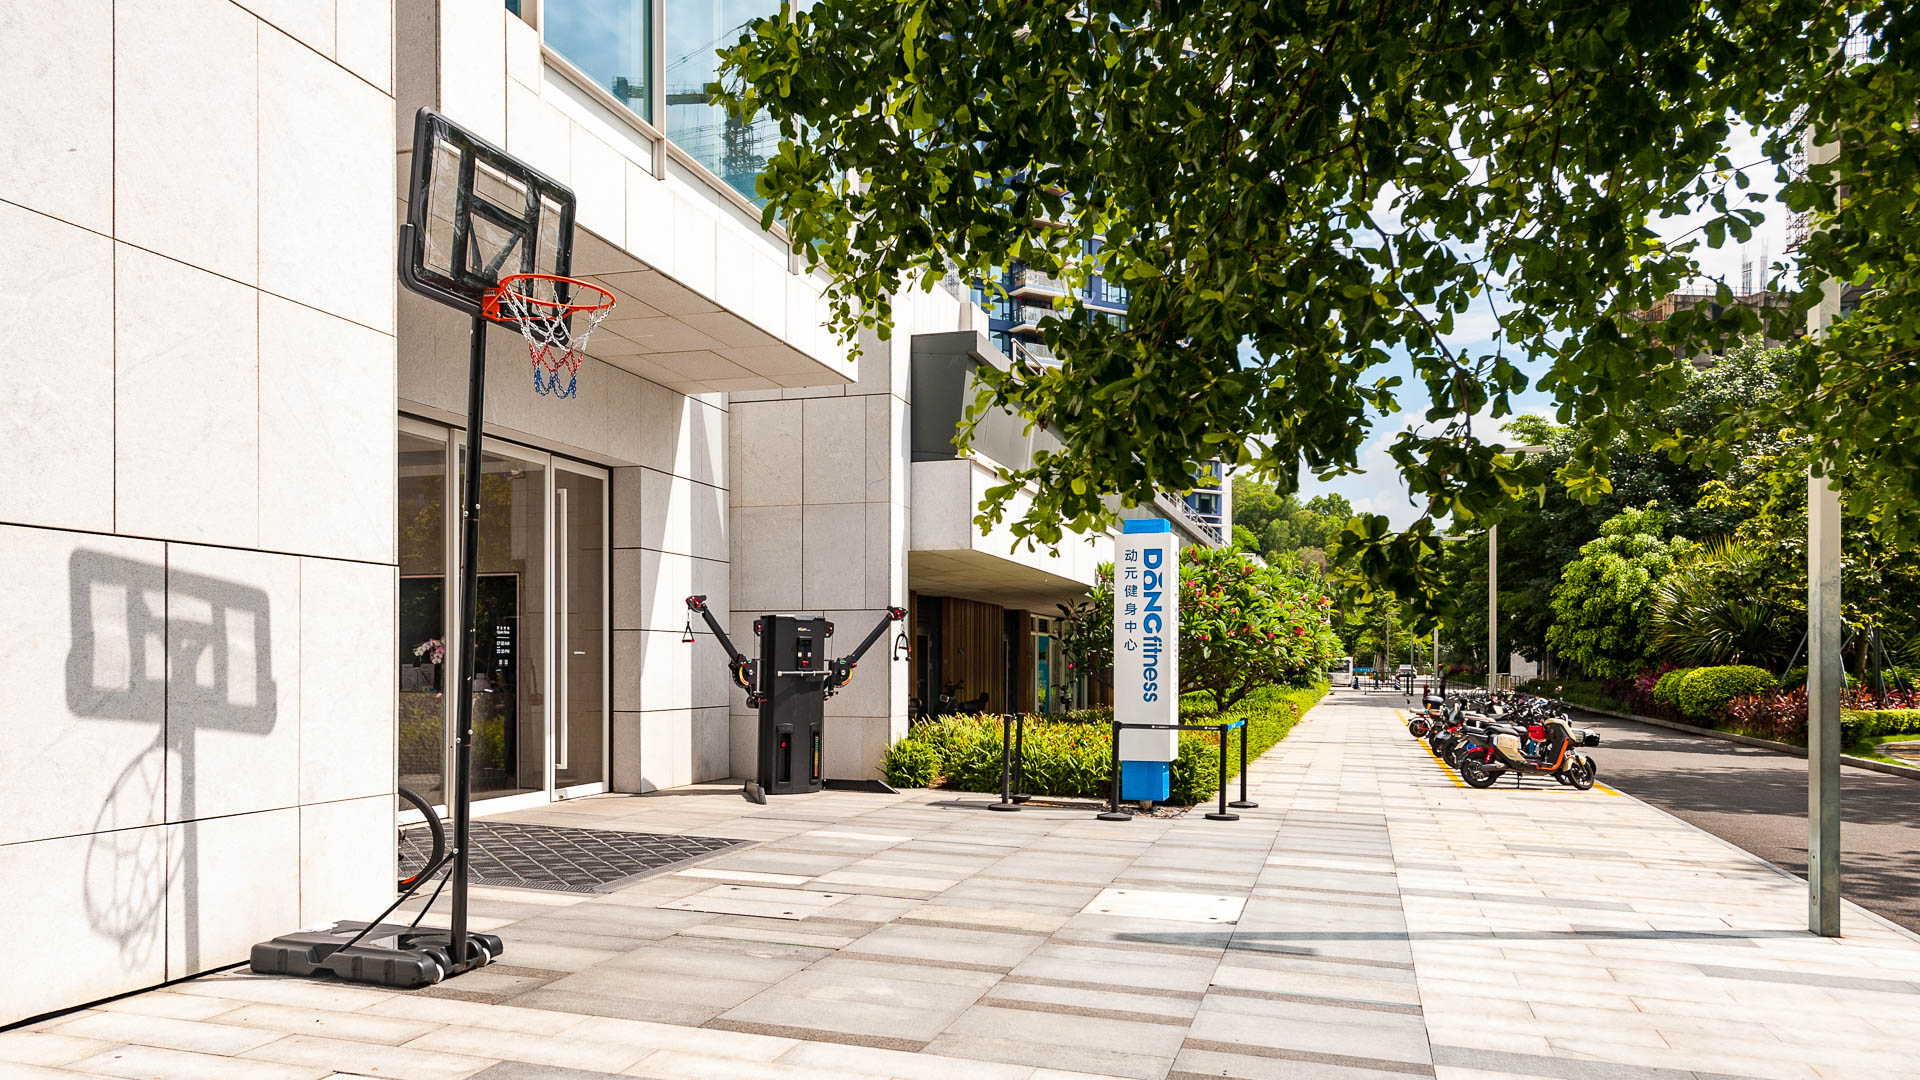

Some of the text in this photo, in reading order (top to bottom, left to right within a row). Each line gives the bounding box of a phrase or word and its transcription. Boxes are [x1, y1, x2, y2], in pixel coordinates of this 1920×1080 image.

[1124, 549, 1138, 651] 动元健身中心
